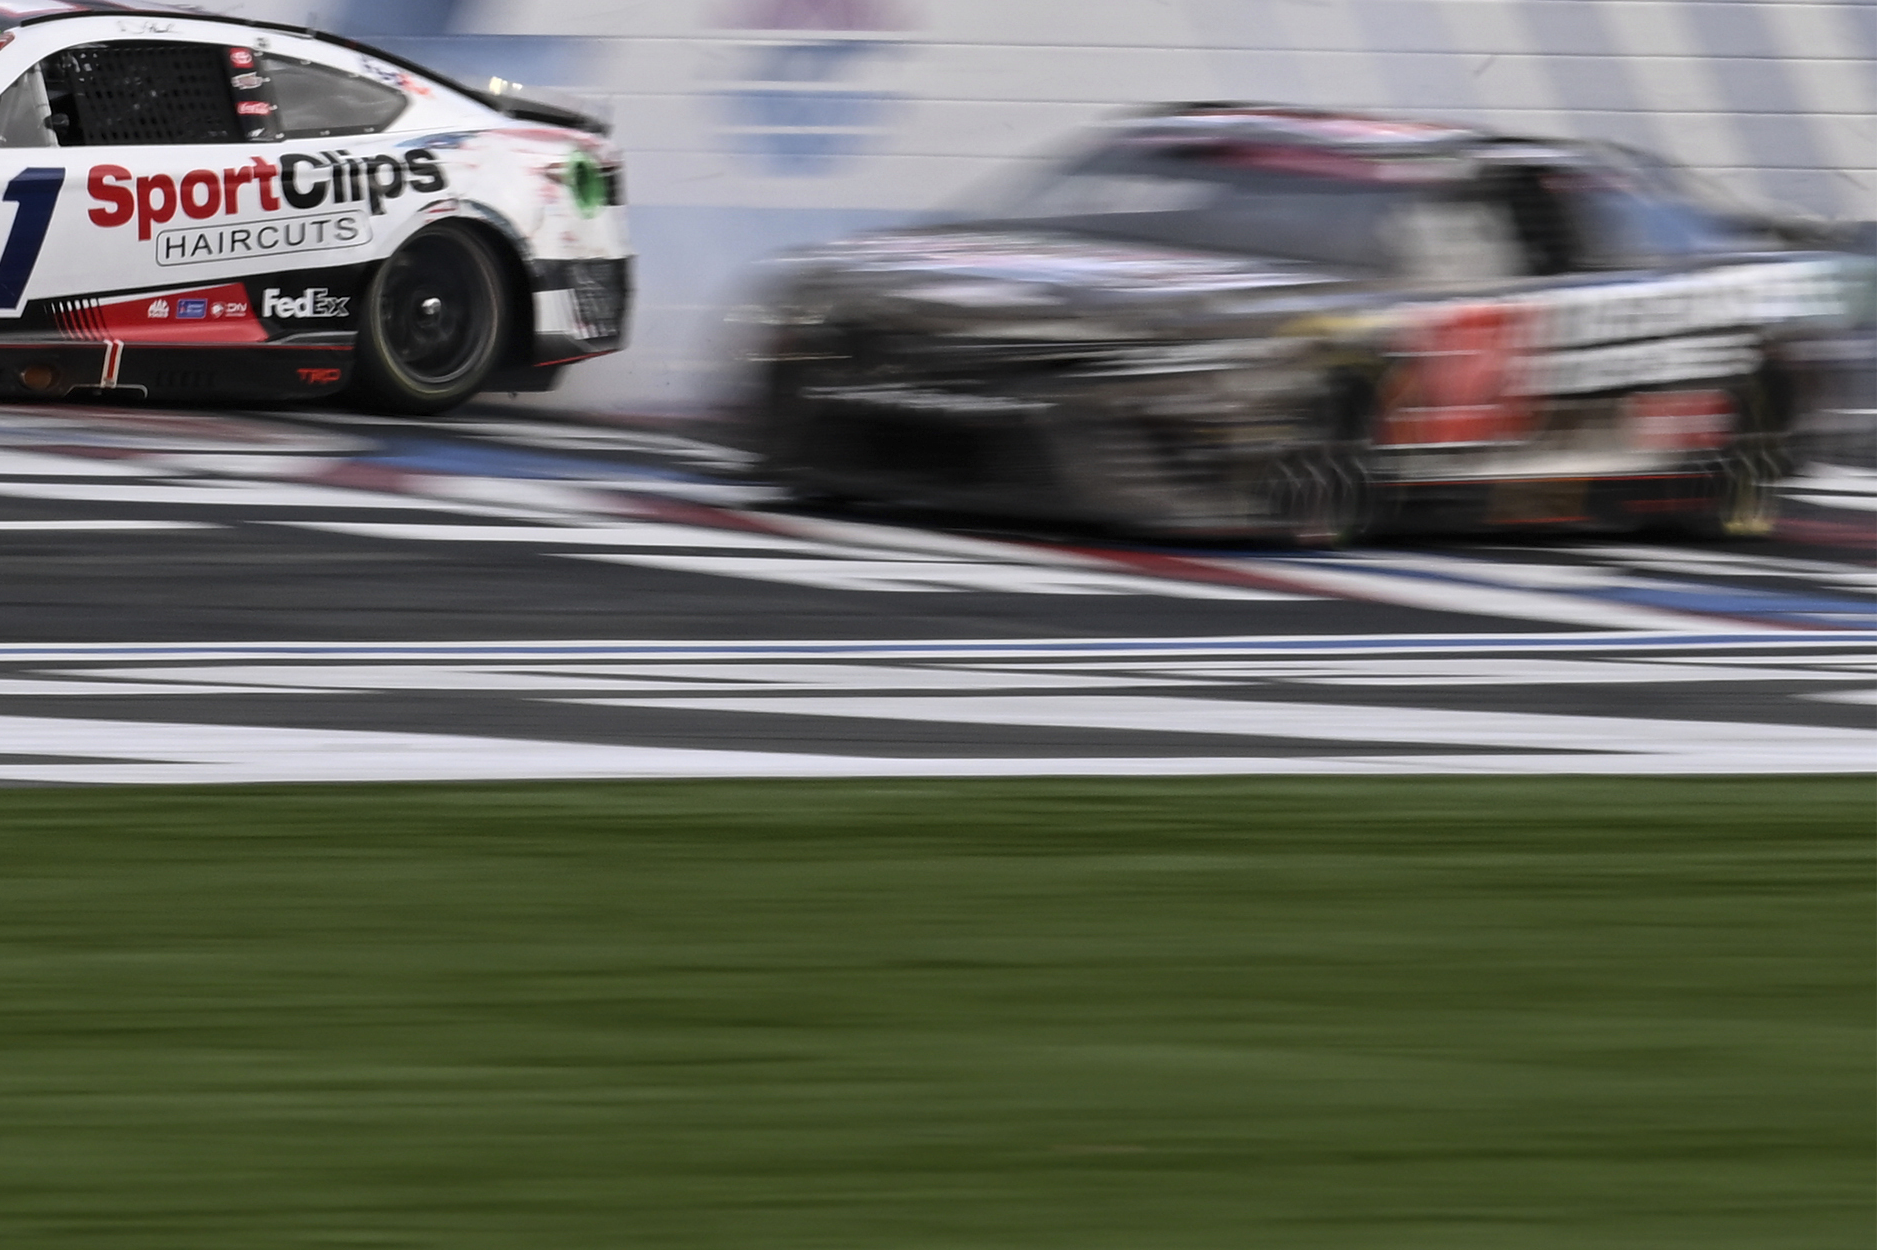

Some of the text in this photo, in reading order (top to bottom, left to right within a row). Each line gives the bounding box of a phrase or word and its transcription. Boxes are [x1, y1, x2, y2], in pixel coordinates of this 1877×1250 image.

[165, 216, 361, 259] HAIRCUTS
[262, 287, 352, 319] FedEx
[296, 368, 342, 384] TRD
